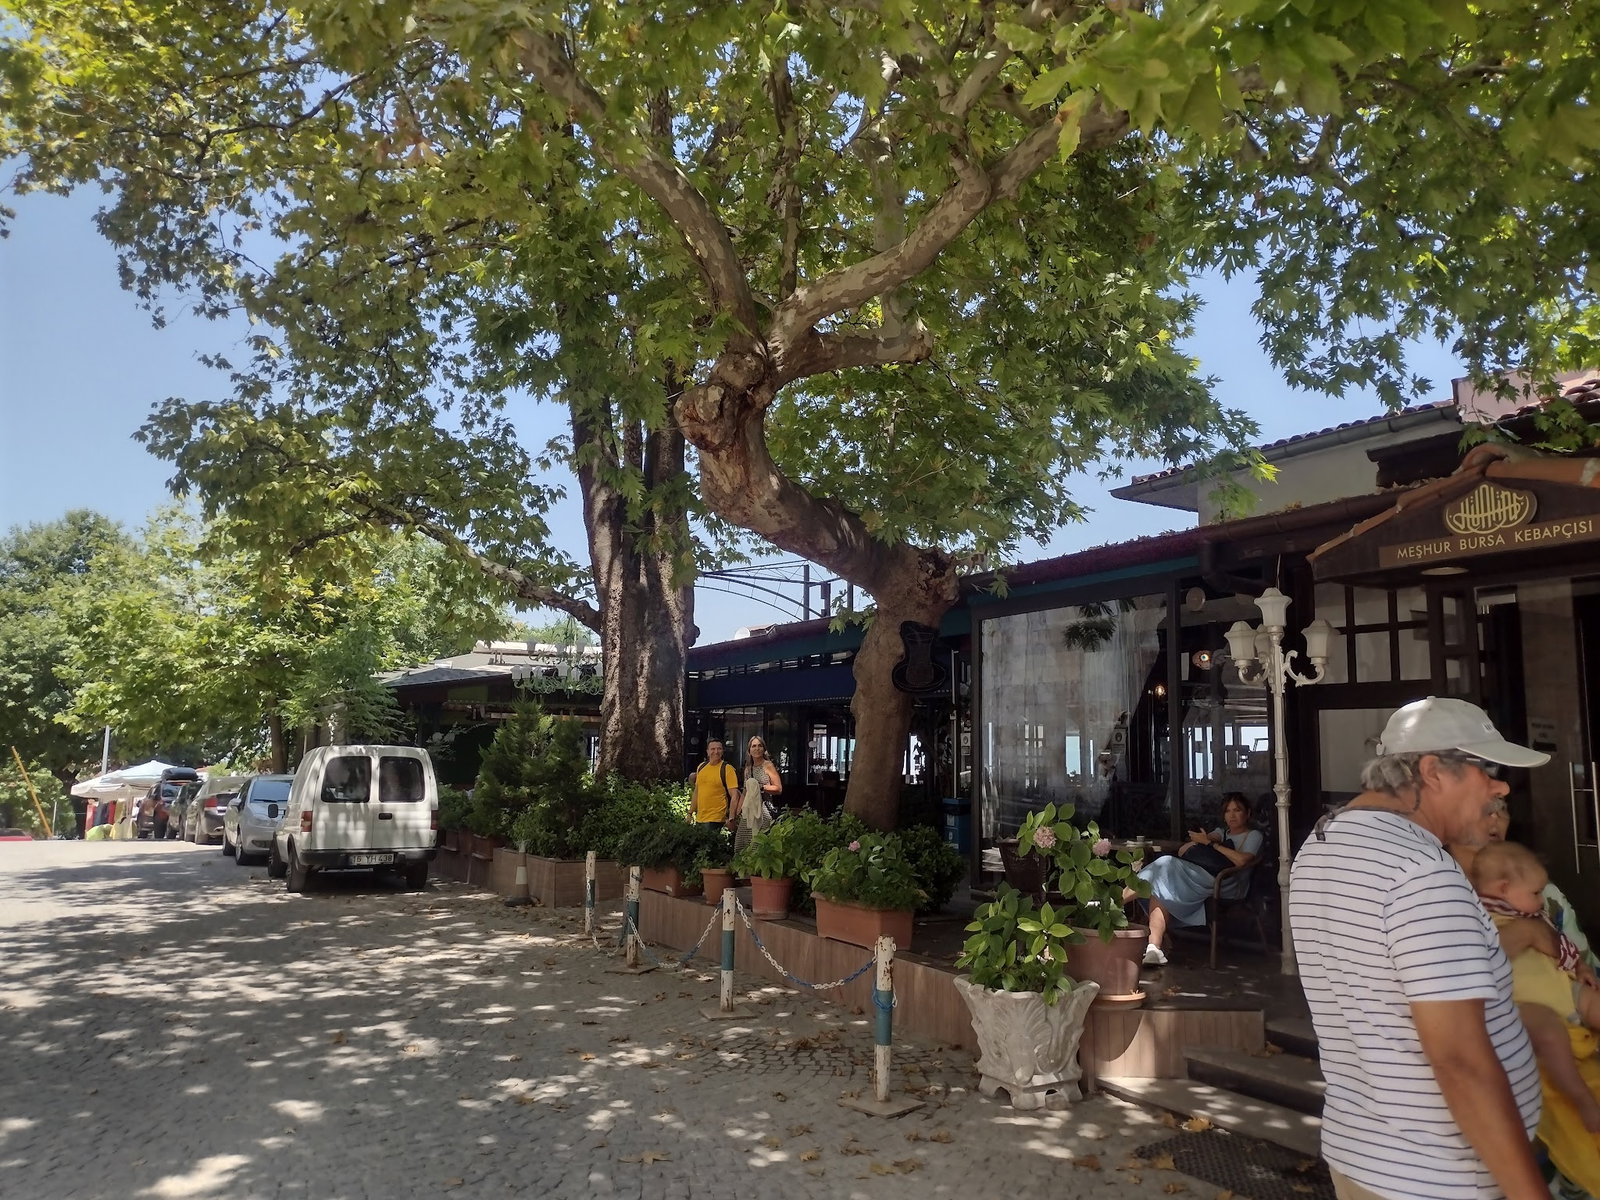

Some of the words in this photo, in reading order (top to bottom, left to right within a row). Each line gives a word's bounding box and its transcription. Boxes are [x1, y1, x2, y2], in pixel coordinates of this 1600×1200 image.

[1397, 541, 1452, 559] MEŞHUR
[1460, 534, 1506, 550] BURSA
[1515, 520, 1593, 543] KEBAPÇISI
